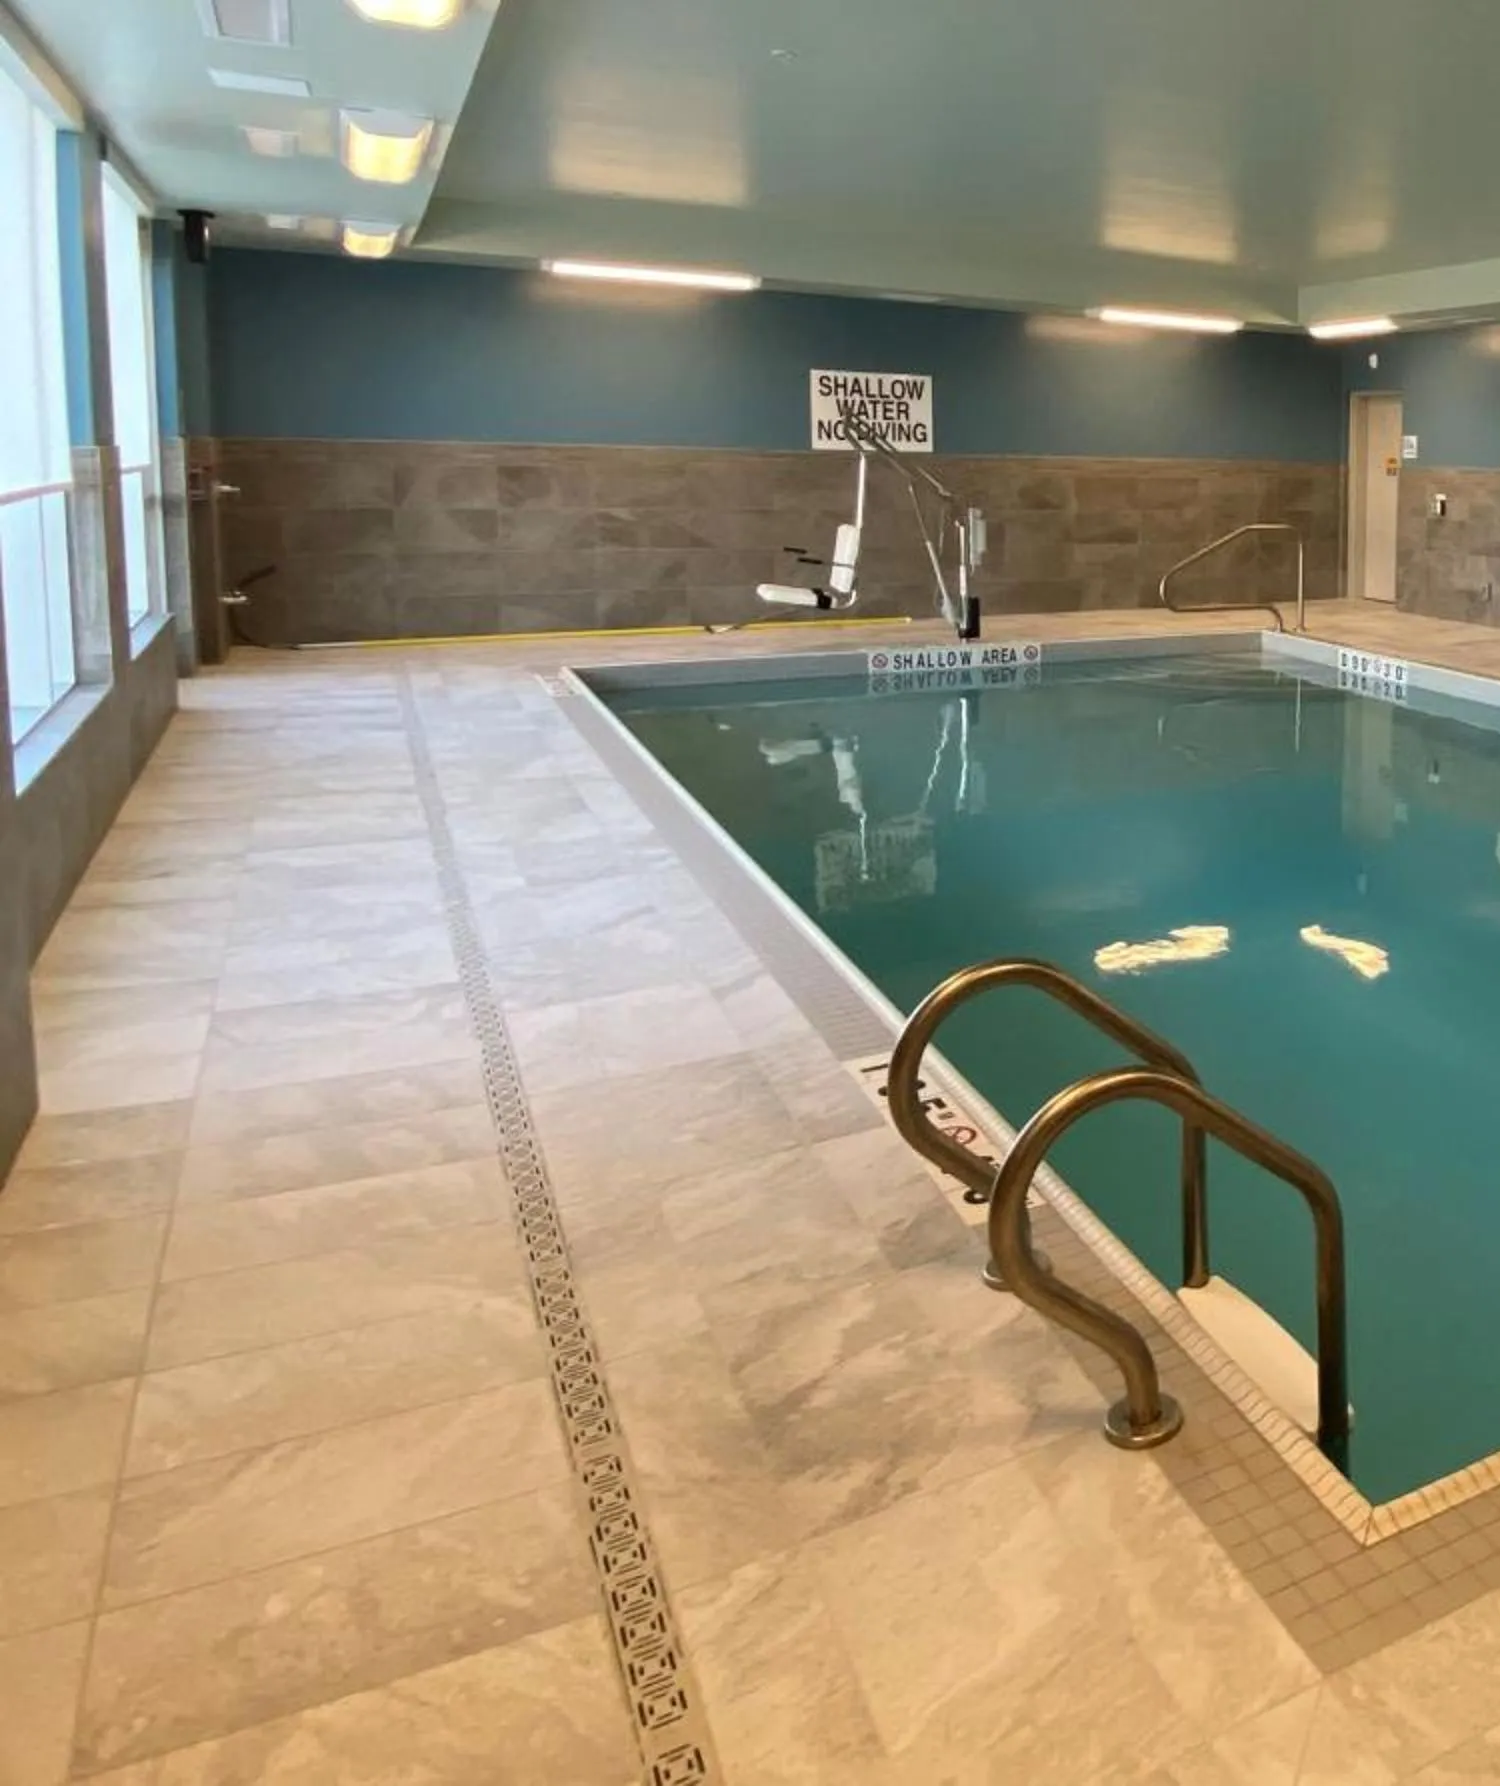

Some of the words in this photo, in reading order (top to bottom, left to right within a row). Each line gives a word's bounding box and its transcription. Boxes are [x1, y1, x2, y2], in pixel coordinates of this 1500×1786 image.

[818, 375, 924, 400] SHALLOW
[836, 398, 909, 420] WATER
[818, 419, 847, 440] NO
[857, 421, 927, 442] DIVING
[893, 651, 971, 670] SHALLOW
[982, 647, 1017, 664] AREA
